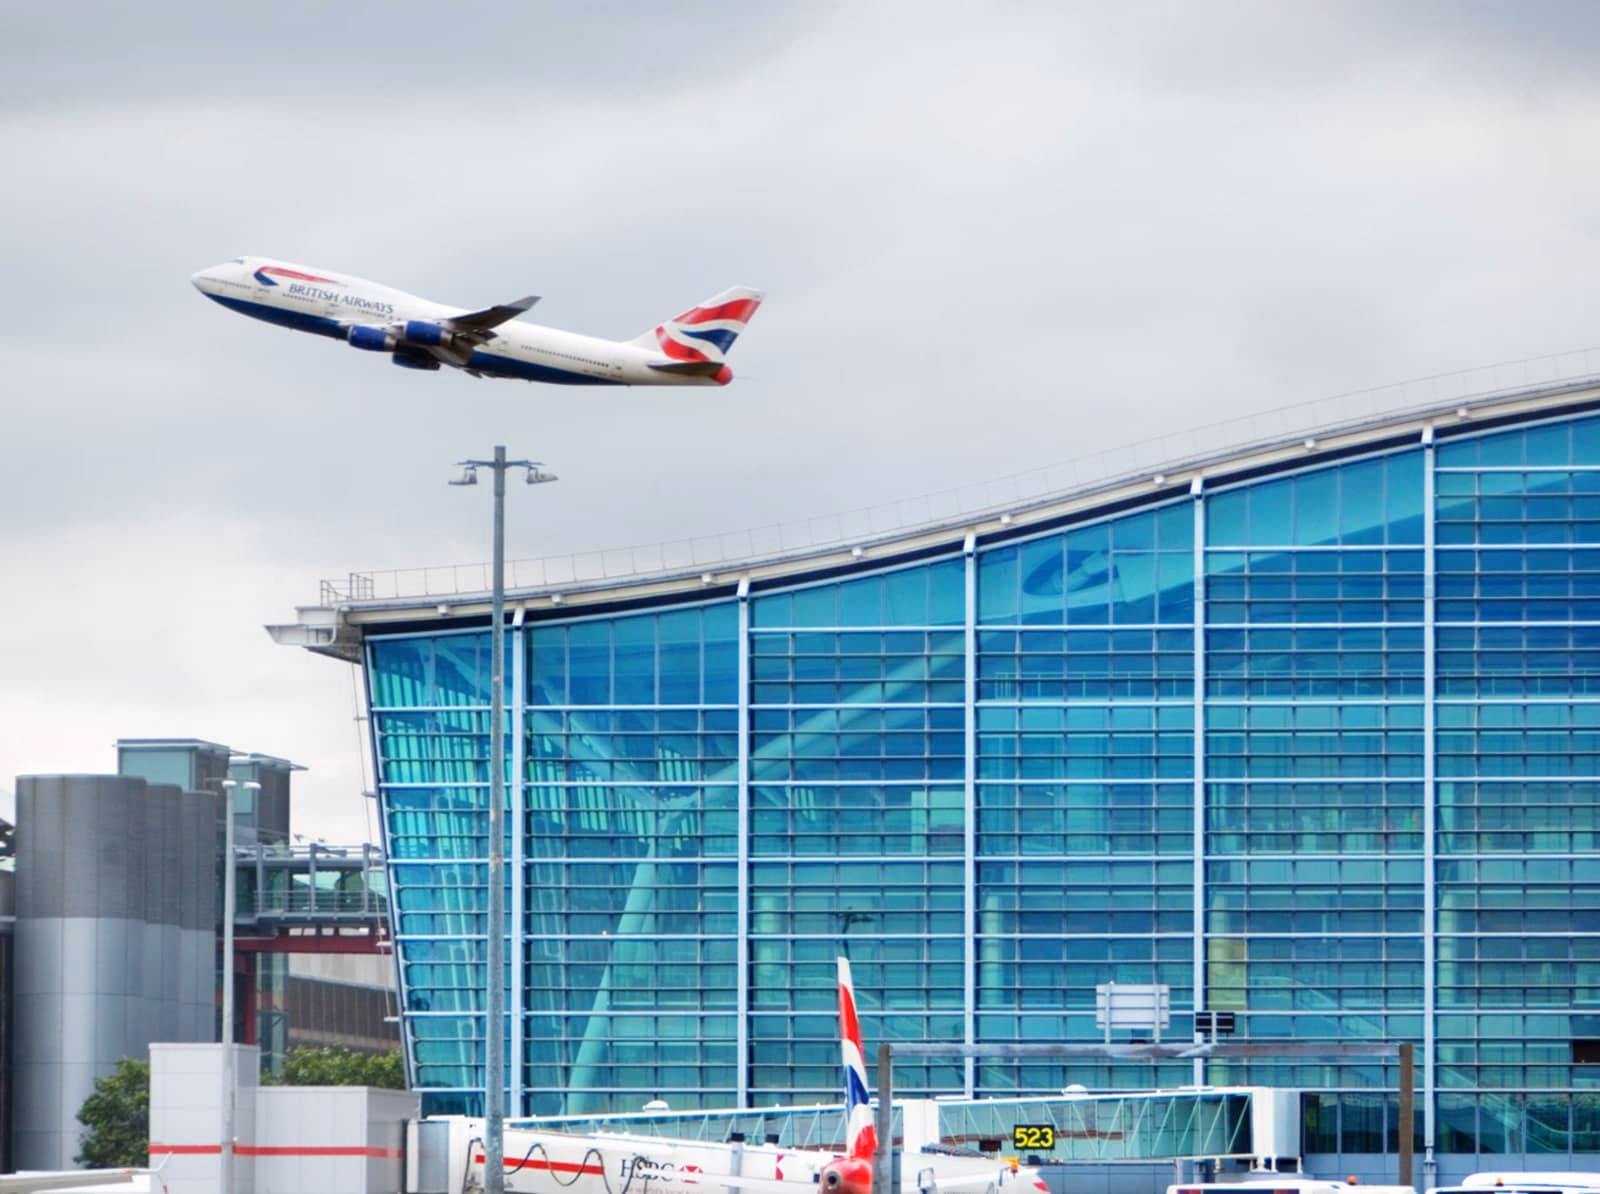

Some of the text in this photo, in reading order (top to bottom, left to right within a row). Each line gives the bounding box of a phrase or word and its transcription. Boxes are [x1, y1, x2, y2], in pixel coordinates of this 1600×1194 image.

[288, 282, 394, 314] BRITISH AIRWAYS
[1015, 1127, 1053, 1147] 523
